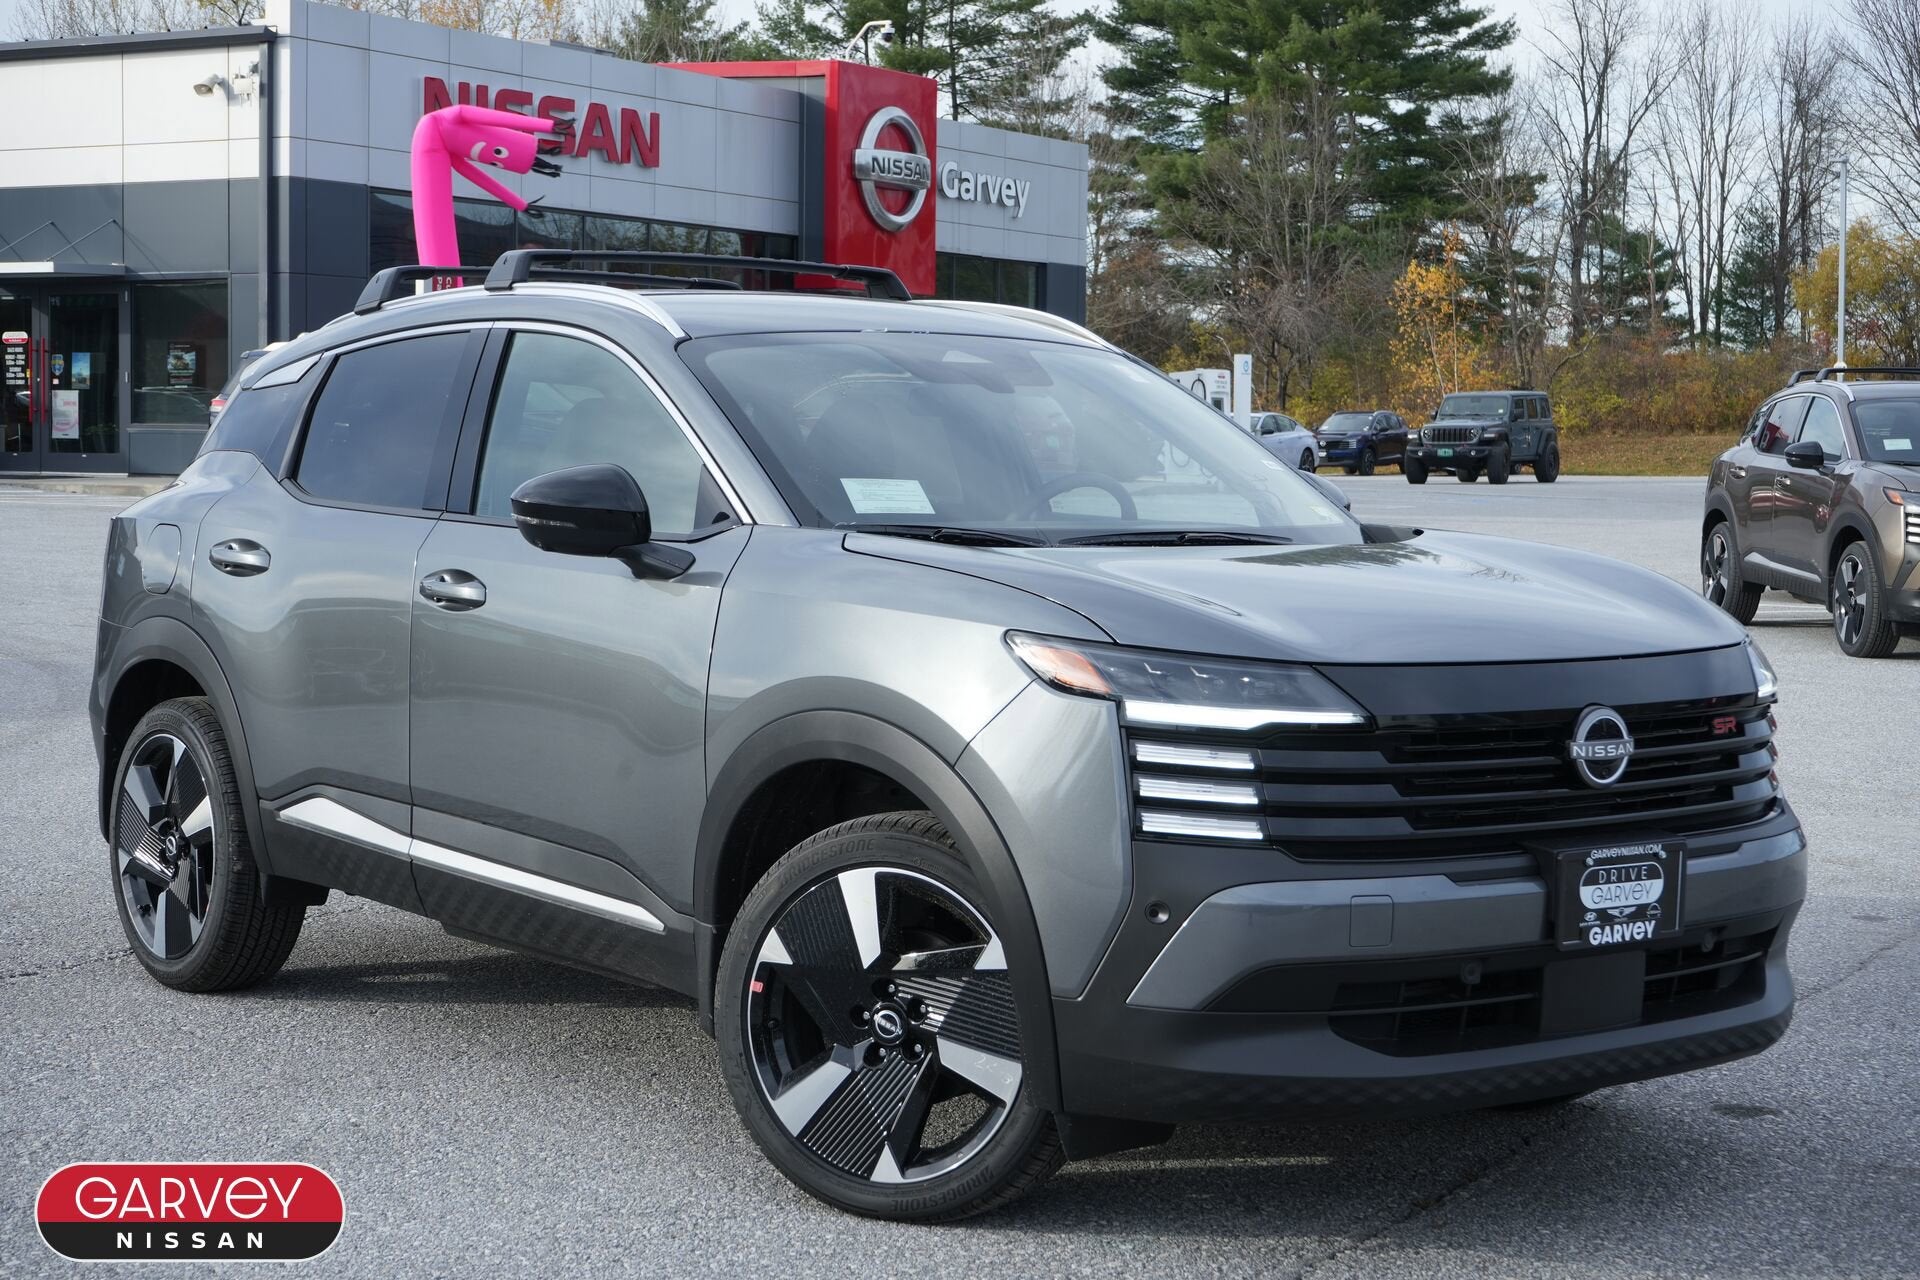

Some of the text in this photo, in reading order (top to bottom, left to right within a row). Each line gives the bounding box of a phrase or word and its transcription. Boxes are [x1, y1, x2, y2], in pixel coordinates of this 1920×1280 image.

[871, 156, 930, 182] NISSAN
[941, 161, 1031, 218] Garvey
[1712, 716, 1737, 734] SR
[1573, 742, 1634, 758] NISSAN
[1599, 866, 1648, 884] DRIVE
